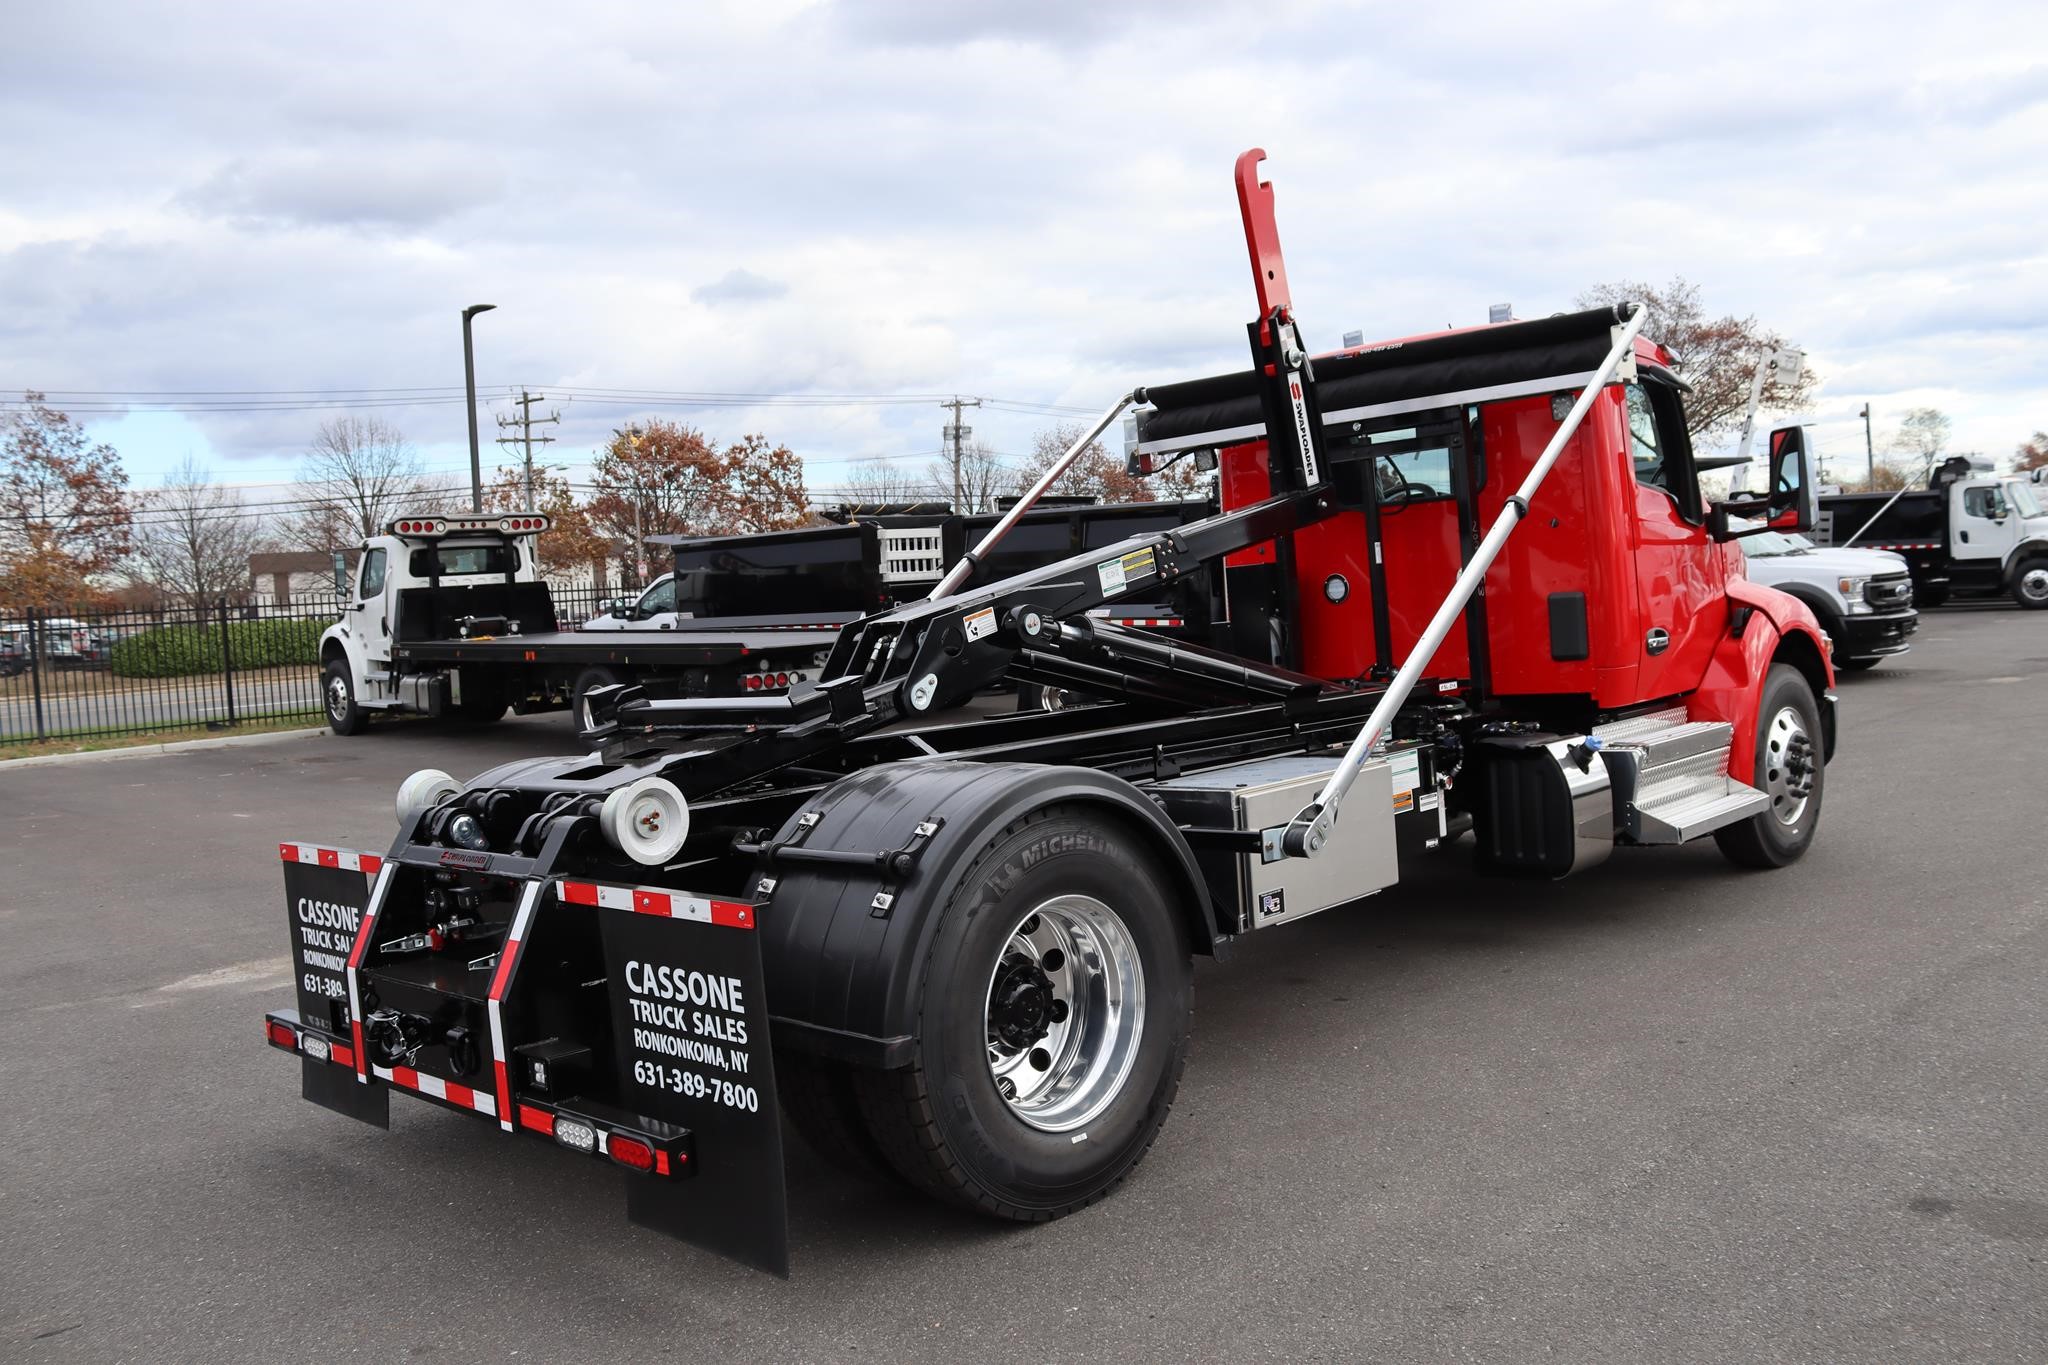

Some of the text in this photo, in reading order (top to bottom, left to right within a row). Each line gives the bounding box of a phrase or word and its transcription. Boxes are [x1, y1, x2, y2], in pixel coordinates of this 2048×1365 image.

[1295, 402, 1314, 477] SWAPLOADER
[1021, 834, 1119, 868] MICHELIN
[298, 897, 360, 933] CASSONE
[300, 926, 354, 954] TRUCK SAL
[304, 973, 347, 998] 631-389-
[625, 960, 745, 1014] CASSONE
[629, 998, 748, 1045] TRUCK SALES
[633, 1028, 749, 1074] RONKONKOMA, NY
[634, 1060, 759, 1113] 631-389-7800
